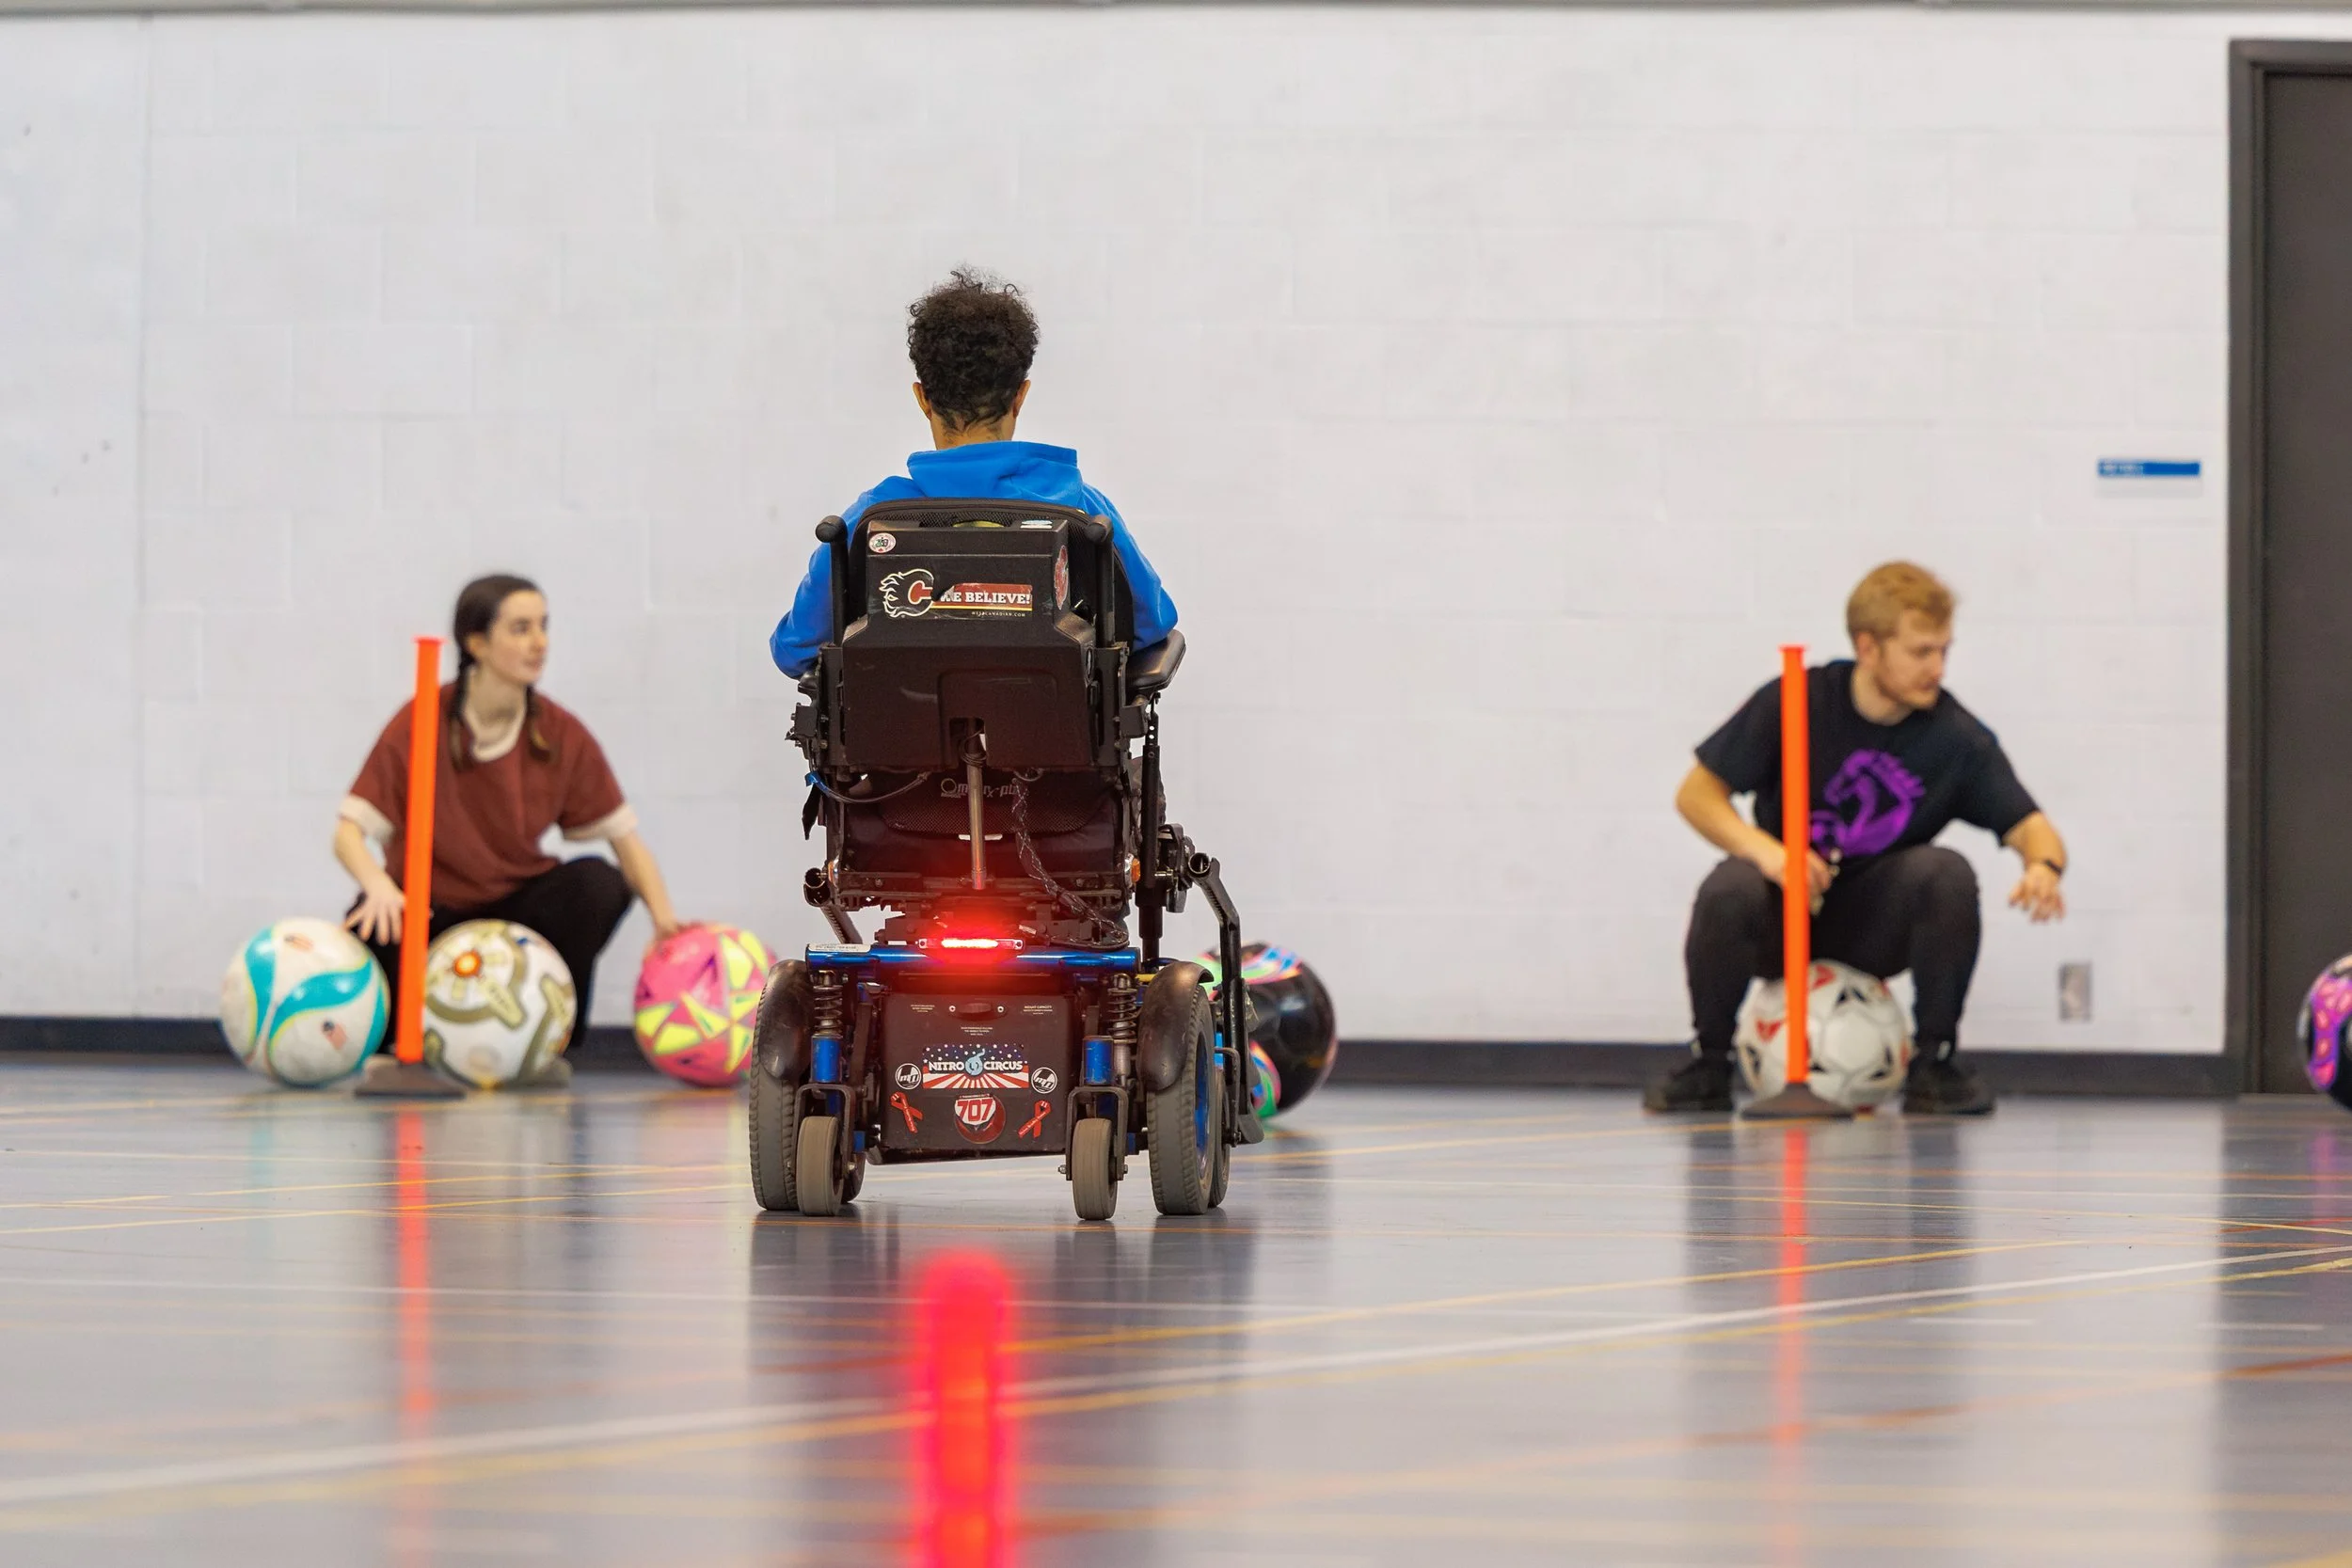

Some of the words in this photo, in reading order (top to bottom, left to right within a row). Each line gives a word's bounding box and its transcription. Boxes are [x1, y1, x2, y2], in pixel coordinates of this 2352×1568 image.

[965, 592, 1030, 604] BELIEVE!
[929, 1061, 965, 1071] NITRO
[983, 1061, 1024, 1071] CIRCUS
[956, 1098, 993, 1122] 707
